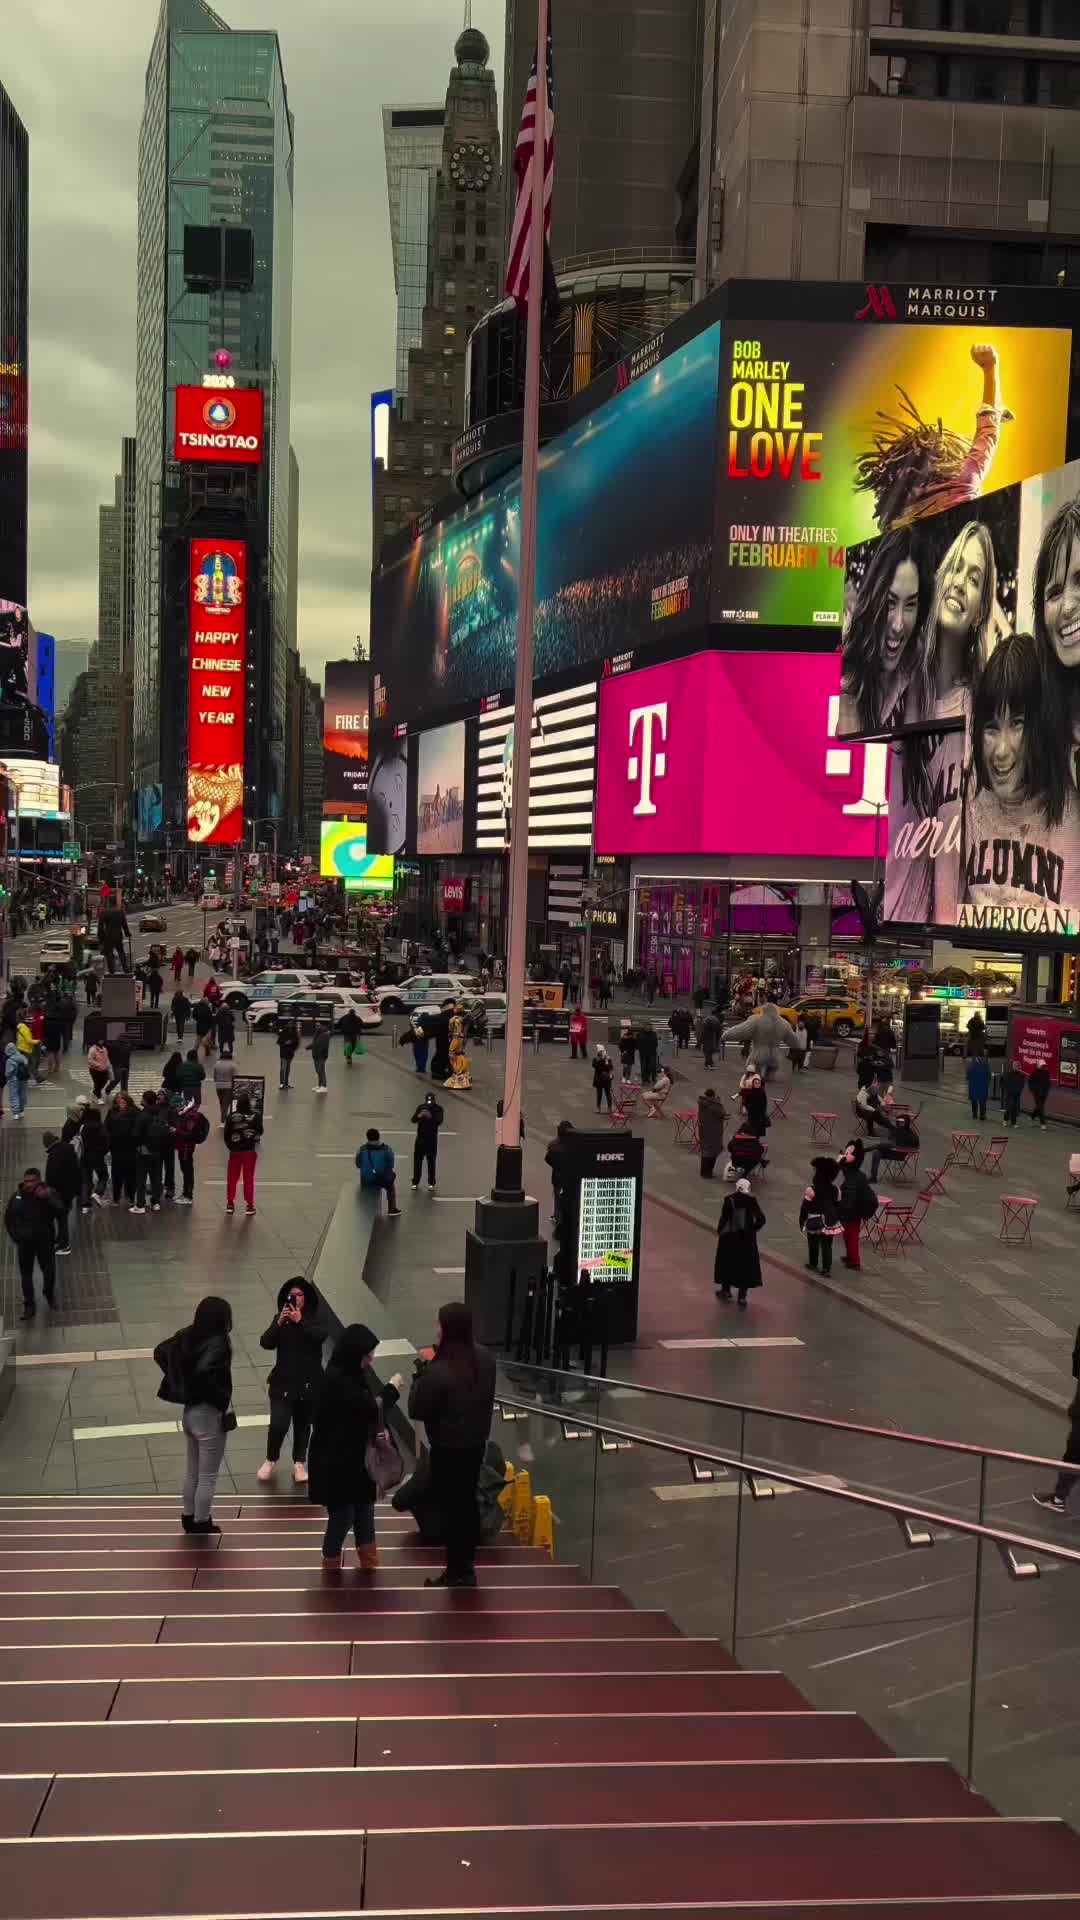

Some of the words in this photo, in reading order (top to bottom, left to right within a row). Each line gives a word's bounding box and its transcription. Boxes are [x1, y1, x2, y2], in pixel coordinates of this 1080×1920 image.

[908, 287, 998, 302] MARRIOTT
[907, 303, 986, 317] MARQUIS
[631, 332, 665, 365] MARRIOTT
[733, 340, 761, 359] BOB
[630, 350, 661, 379] MARQUIS
[732, 360, 790, 380] MARLEY
[202, 374, 236, 388] 2024
[730, 381, 805, 430] ONE
[179, 432, 258, 450] TSINGTAO
[728, 431, 823, 480] LOVE
[729, 524, 760, 541] ONLY
[762, 525, 775, 542] IN
[778, 526, 838, 543] THEATRES
[728, 542, 819, 568] FEBRUARY
[827, 545, 845, 568] 14
[194, 631, 239, 645] HAPPY
[191, 658, 242, 672] CHINESE
[201, 685, 232, 698] NEW
[199, 711, 235, 724] YEAR
[335, 714, 360, 730] FIRE
[584, 909, 617, 925] SPHORA
[959, 904, 1070, 933] AMERICAN
